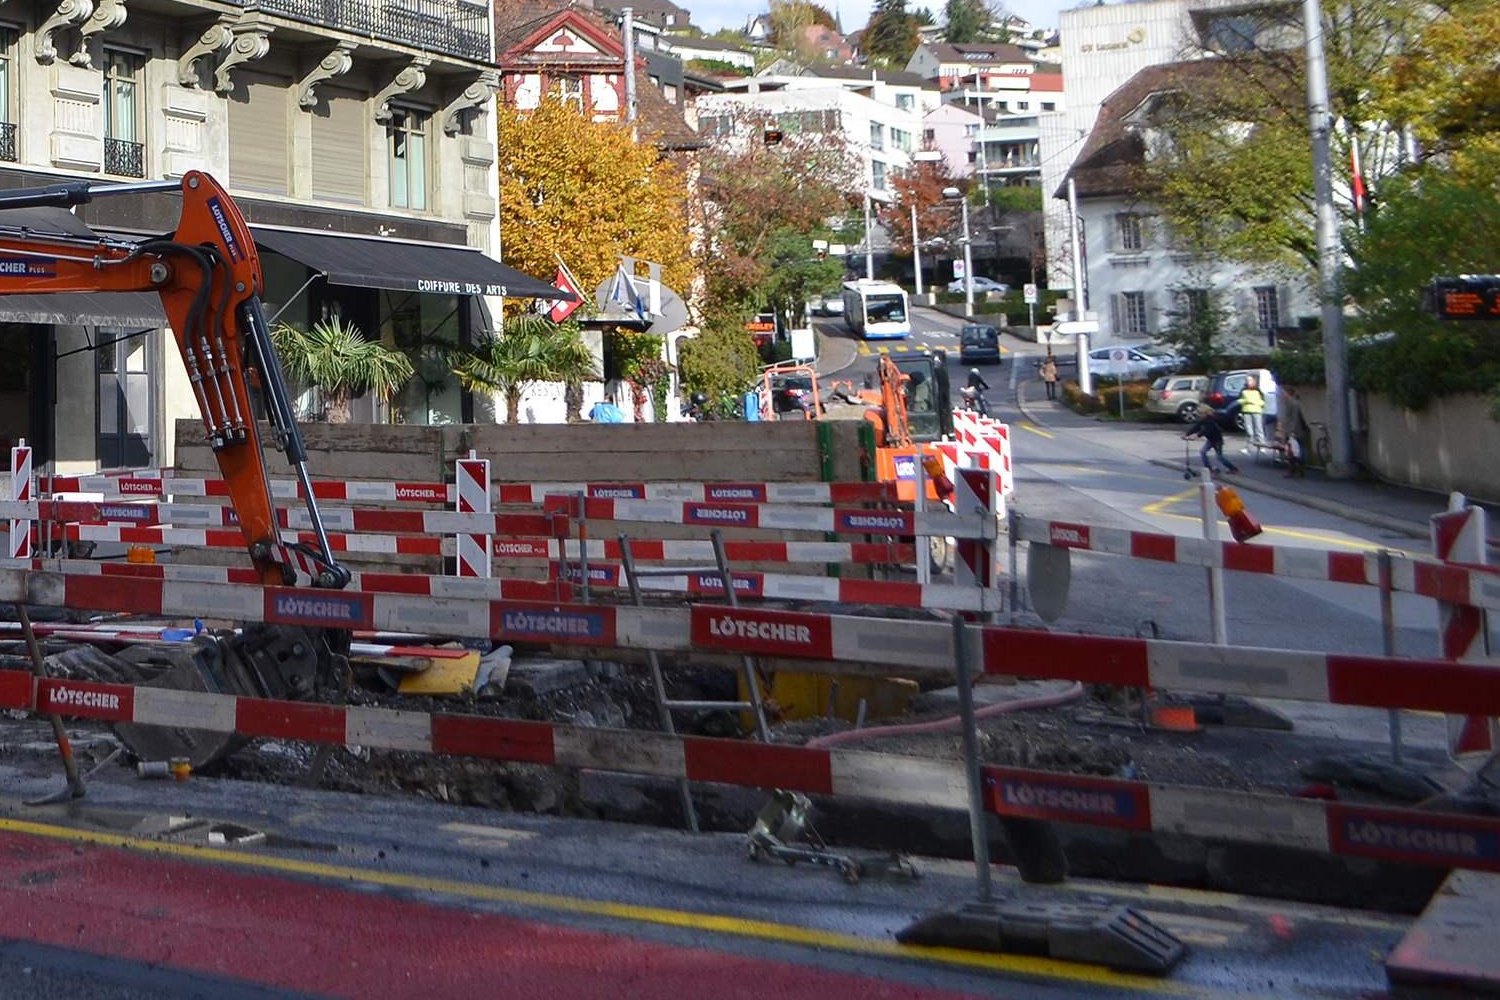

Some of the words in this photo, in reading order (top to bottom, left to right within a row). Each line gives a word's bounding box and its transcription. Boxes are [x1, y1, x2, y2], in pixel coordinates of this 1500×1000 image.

[28, 266, 46, 274] PLUS
[418, 279, 460, 293] COIFFURE
[465, 282, 482, 294] DES
[486, 283, 508, 297] ARTS
[121, 481, 153, 491] LÖTSCHER
[396, 487, 435, 498] LÖTSCHER
[593, 488, 633, 498] LÖTSCHER
[711, 488, 753, 498] LÖTSCHER
[102, 506, 143, 517] LÖTSCHER
[495, 543, 533, 554] LÖTSCHER
[278, 598, 351, 618] LÖTSCHER
[506, 611, 590, 635] LÖTSCHER
[710, 615, 812, 644] LÖTSCHER
[50, 686, 120, 709] LÖTSCHER
[1005, 781, 1117, 814] LÖTSCHER
